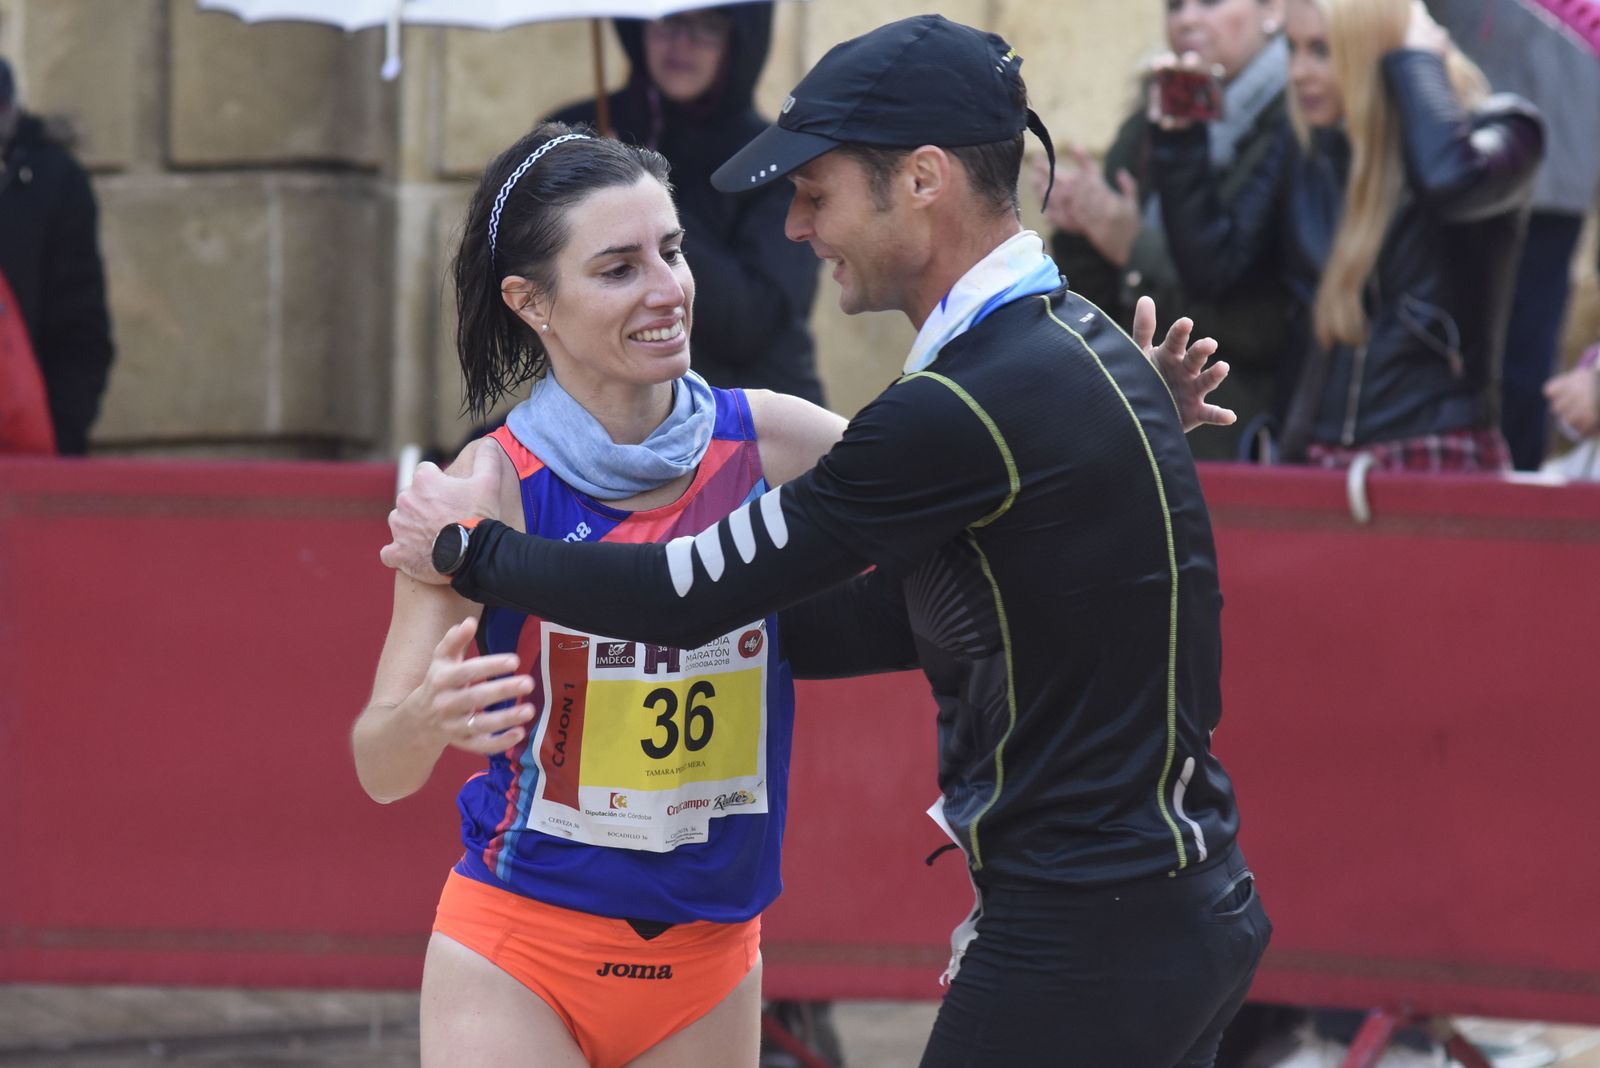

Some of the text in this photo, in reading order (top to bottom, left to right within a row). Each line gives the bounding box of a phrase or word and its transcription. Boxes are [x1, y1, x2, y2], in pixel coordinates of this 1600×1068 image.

[704, 636, 730, 648] EDIA
[596, 655, 636, 665] IMDECO
[685, 647, 730, 663] MARATÓN
[713, 658, 730, 667] 2018
[551, 682, 575, 768] CAJON 1
[640, 680, 716, 760] 36
[645, 768, 675, 777] TAMARA
[687, 760, 706, 768] MERA
[585, 809, 617, 817] Diputación
[627, 812, 652, 820] Córdoba
[596, 962, 673, 980] Joma
